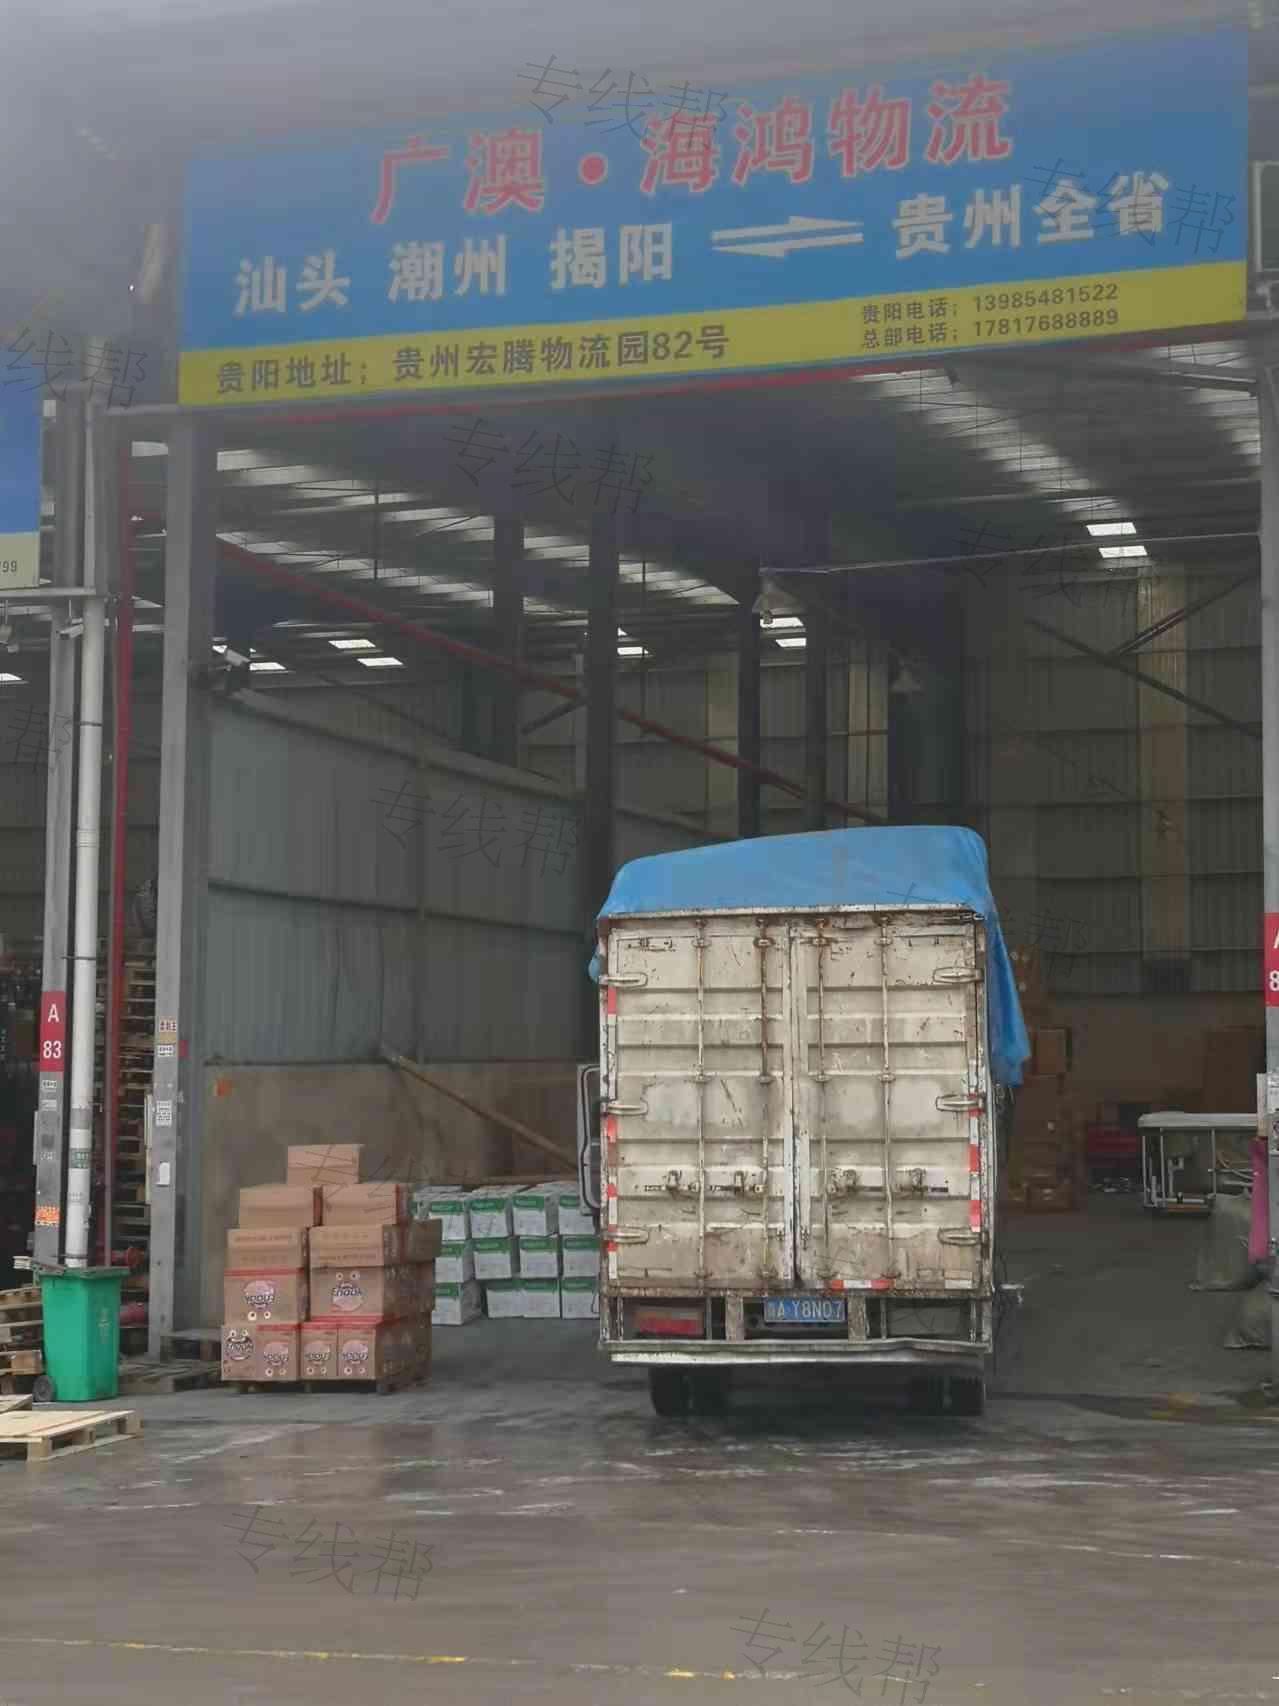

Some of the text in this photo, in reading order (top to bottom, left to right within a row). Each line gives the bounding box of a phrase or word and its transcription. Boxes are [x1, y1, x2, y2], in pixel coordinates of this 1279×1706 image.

[233, 170, 1170, 320] 汕头 潮州 揭阳 贵州全省
[392, 323, 730, 383] 贵州宏腾物流园82号
[48, 1004, 60, 1023] A
[43, 1040, 62, 1059] 83
